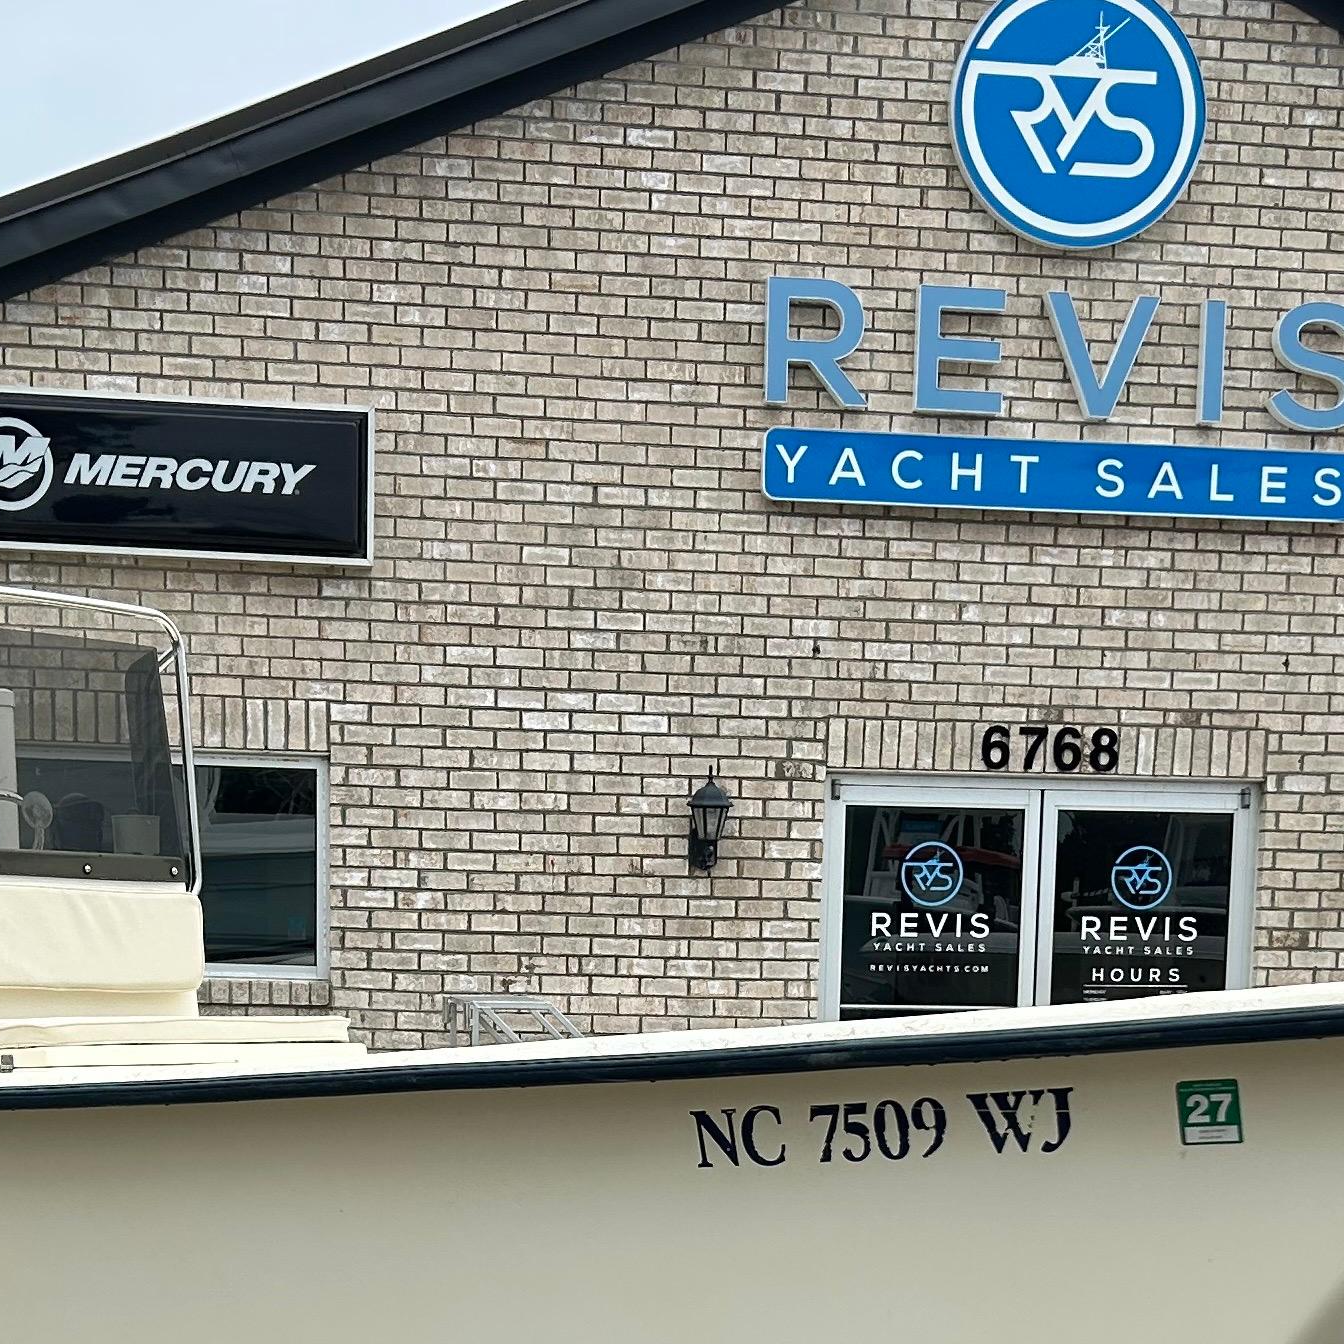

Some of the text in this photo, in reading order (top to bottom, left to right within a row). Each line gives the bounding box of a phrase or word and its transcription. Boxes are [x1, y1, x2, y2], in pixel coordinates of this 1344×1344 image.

[63, 452, 317, 496] MERCURY
[775, 443, 1344, 506] YACHT SALES
[981, 724, 1120, 773] 6768
[870, 912, 990, 939] REVIS
[1080, 915, 1198, 942] REVIS
[873, 942, 987, 953] YACHT SALES
[1082, 945, 1194, 956] YACHT SALES
[869, 964, 990, 973] REVISYACHTS.COM
[1091, 967, 1181, 982] HOURS
[1186, 1093, 1233, 1124] 27
[689, 1086, 1075, 1169] NC 7509 WJ
